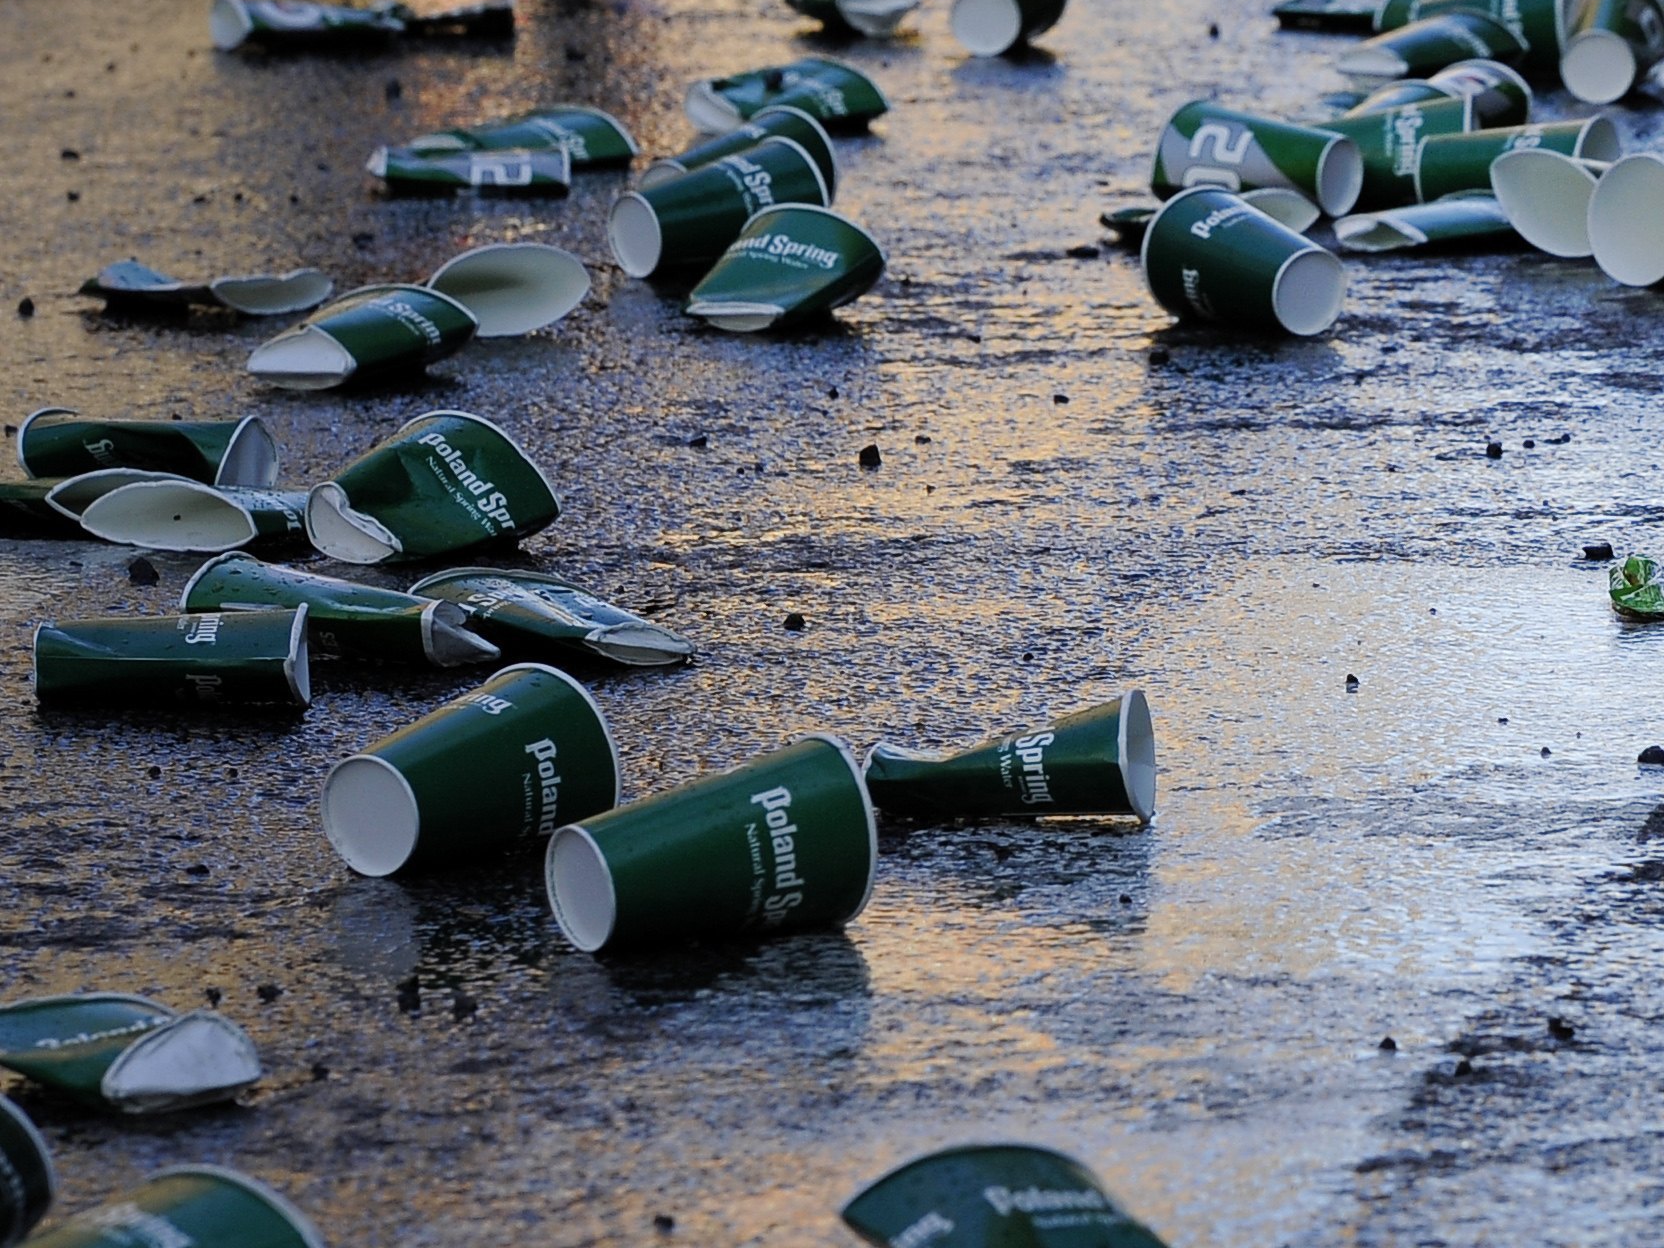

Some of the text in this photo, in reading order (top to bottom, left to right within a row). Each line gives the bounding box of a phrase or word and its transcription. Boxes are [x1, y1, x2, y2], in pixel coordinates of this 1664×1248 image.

[768, 234, 838, 269] Spring
[417, 432, 495, 496] Poland
[1015, 732, 1056, 805] Spring
[744, 822, 767, 876] Natural
[750, 785, 805, 890] Poland
